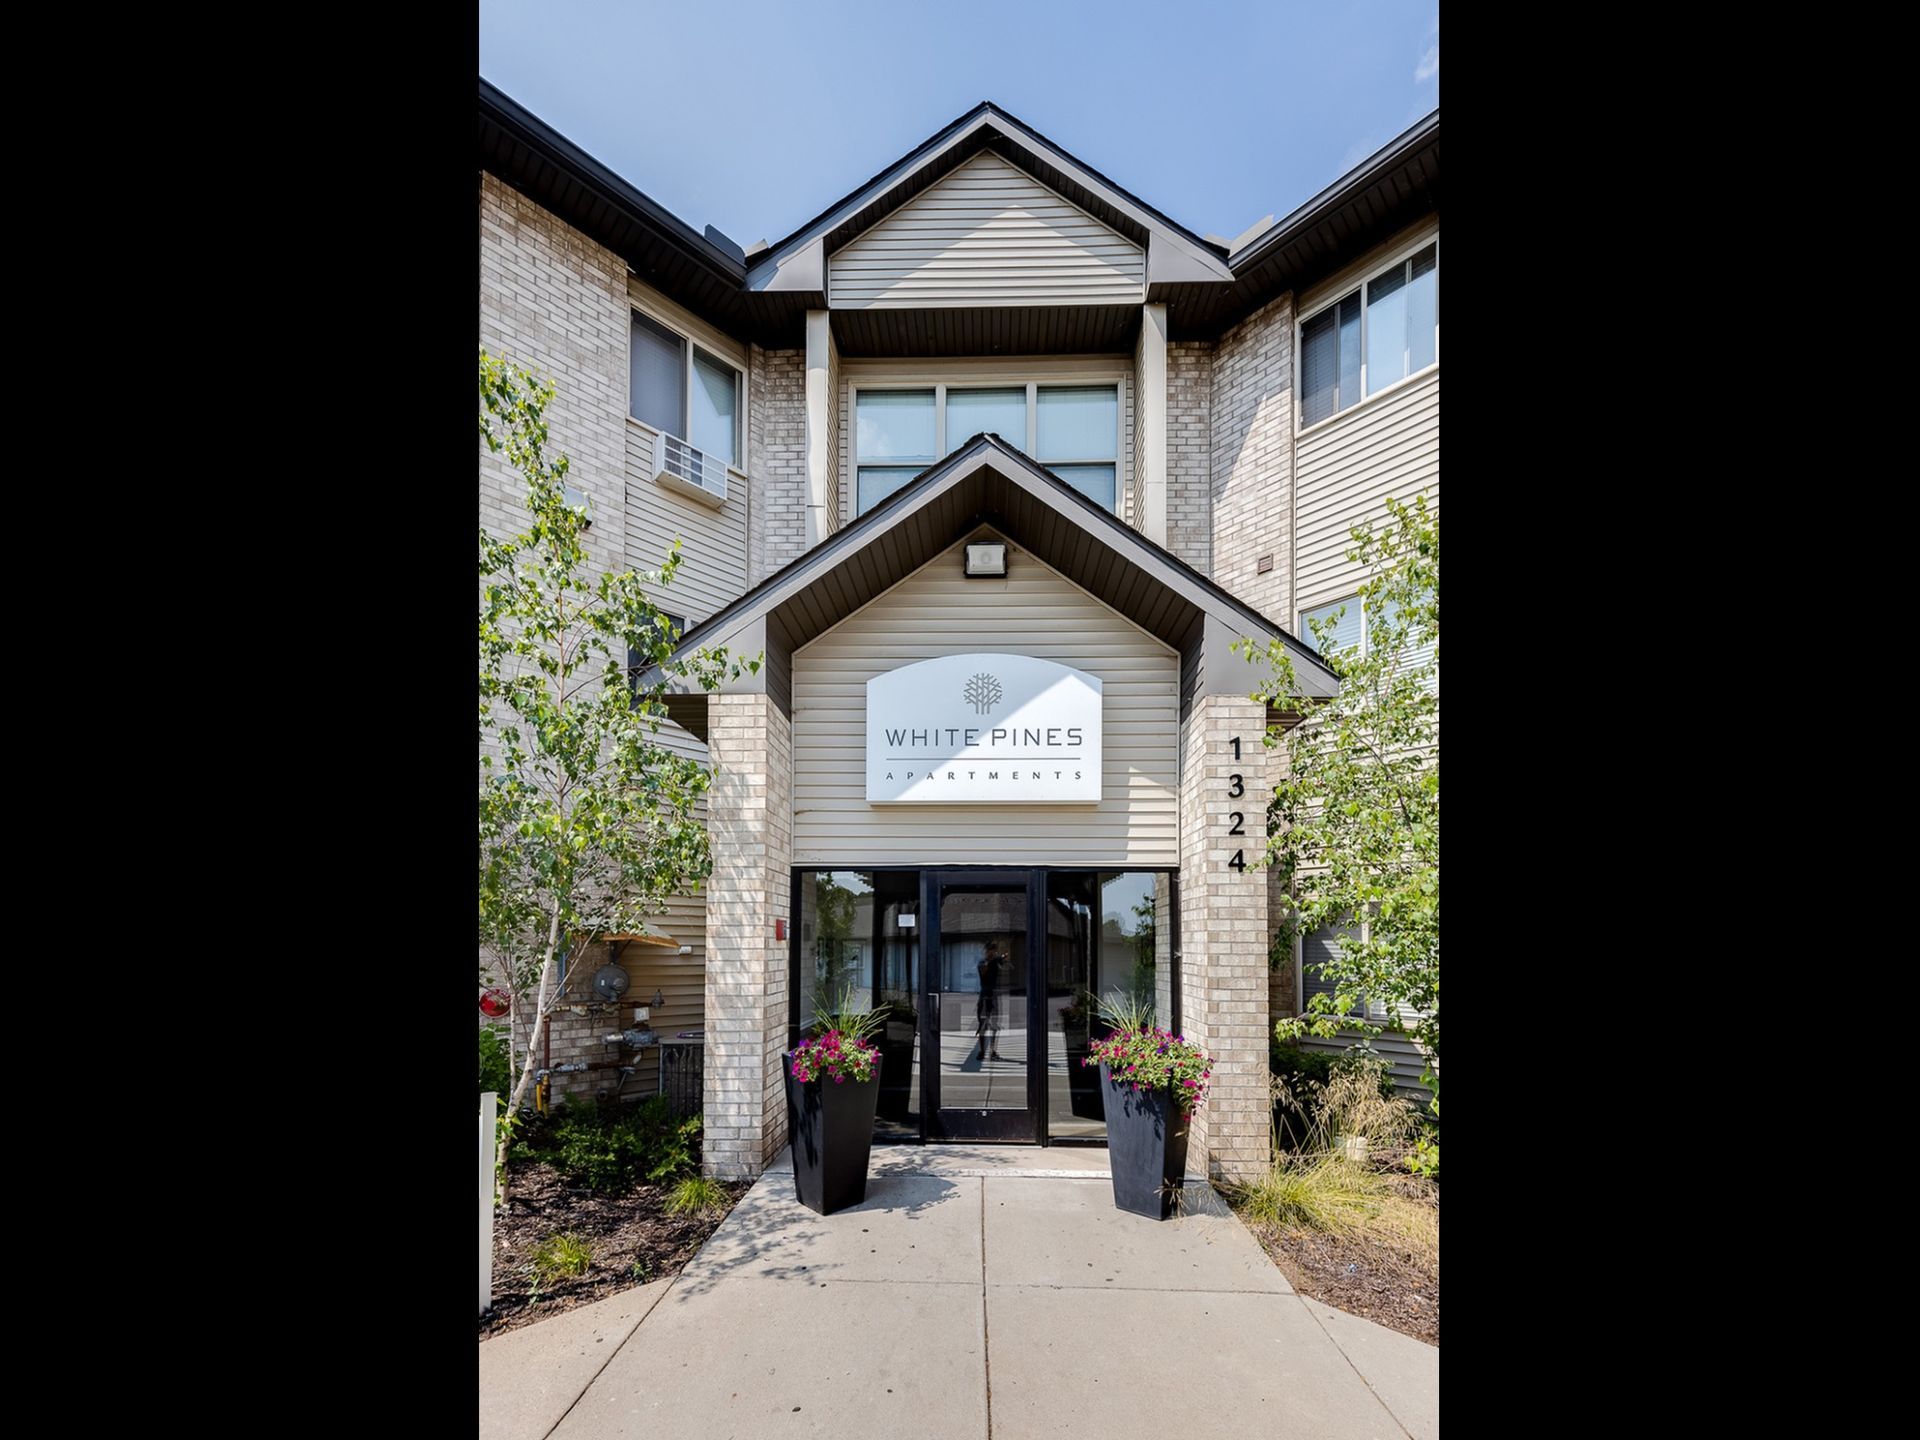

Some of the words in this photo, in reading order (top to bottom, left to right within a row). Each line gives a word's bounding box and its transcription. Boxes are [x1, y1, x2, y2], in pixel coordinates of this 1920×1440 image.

[885, 728, 980, 747] WHITE
[991, 728, 1083, 747] PINES
[885, 771, 1082, 781] APARTMENTS
[1227, 736, 1247, 873] 1324
